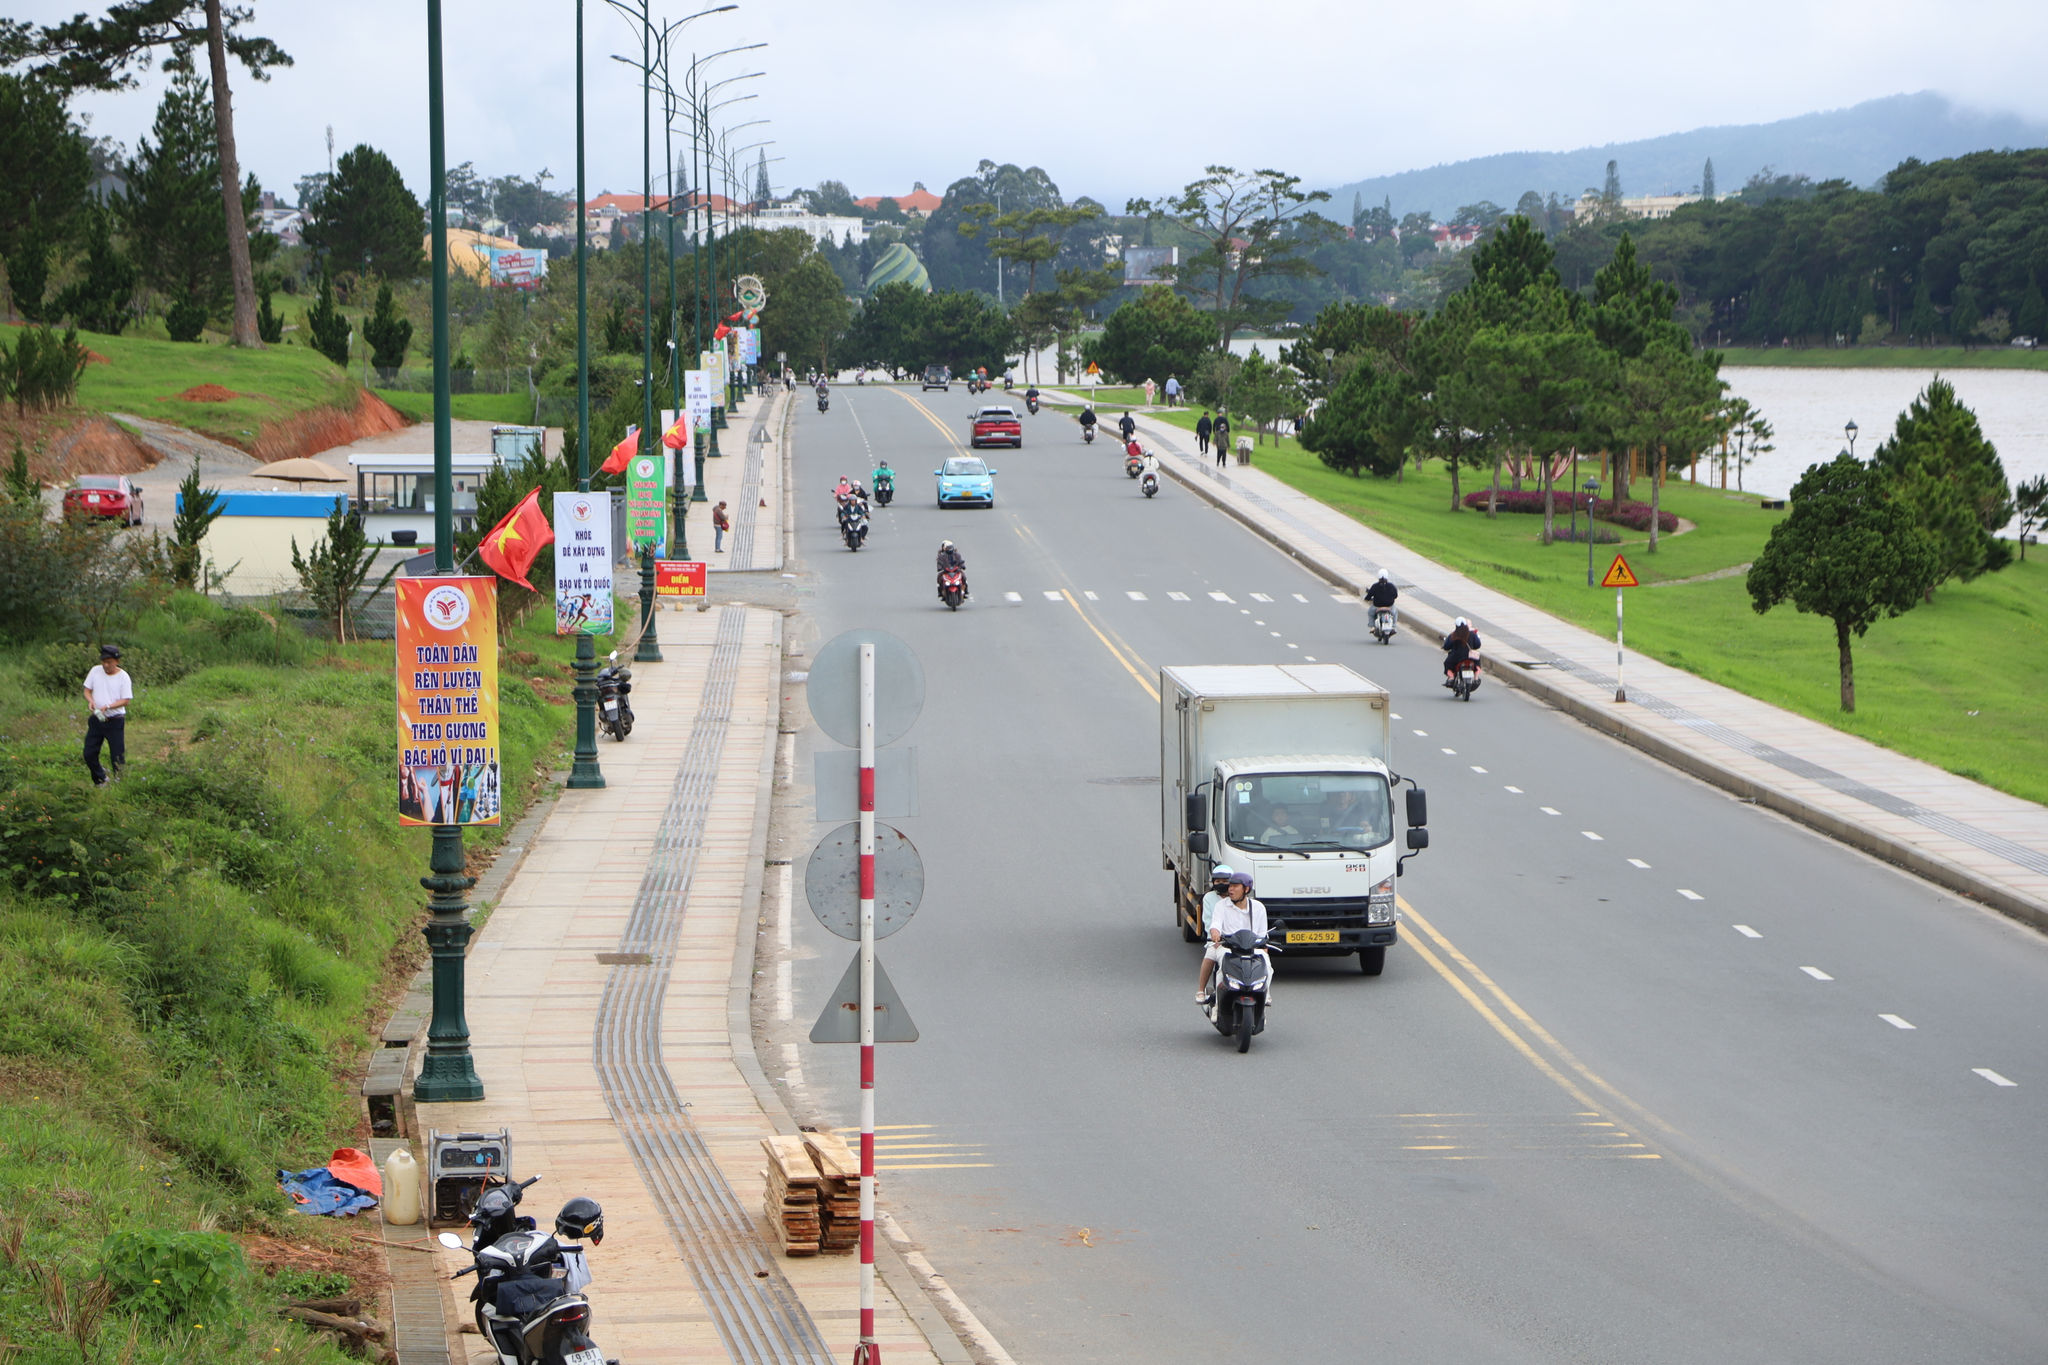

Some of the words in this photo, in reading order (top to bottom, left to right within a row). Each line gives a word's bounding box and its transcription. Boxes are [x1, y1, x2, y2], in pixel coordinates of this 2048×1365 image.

[416, 643, 449, 664] TOÀN
[452, 642, 478, 664] DÂN
[414, 670, 440, 689] RÈN
[443, 669, 482, 692] LUYỆN
[419, 696, 452, 715] THÂN
[455, 691, 478, 714] THỂ
[411, 722, 442, 741] THEO
[446, 721, 486, 741] GƯƠNG
[404, 746, 428, 766] BÁC
[430, 743, 446, 766] HỒ
[464, 747, 486, 769] ĐẠI
[1292, 886, 1332, 894] ISUZU
[571, 1350, 596, 1364] 49-B1
